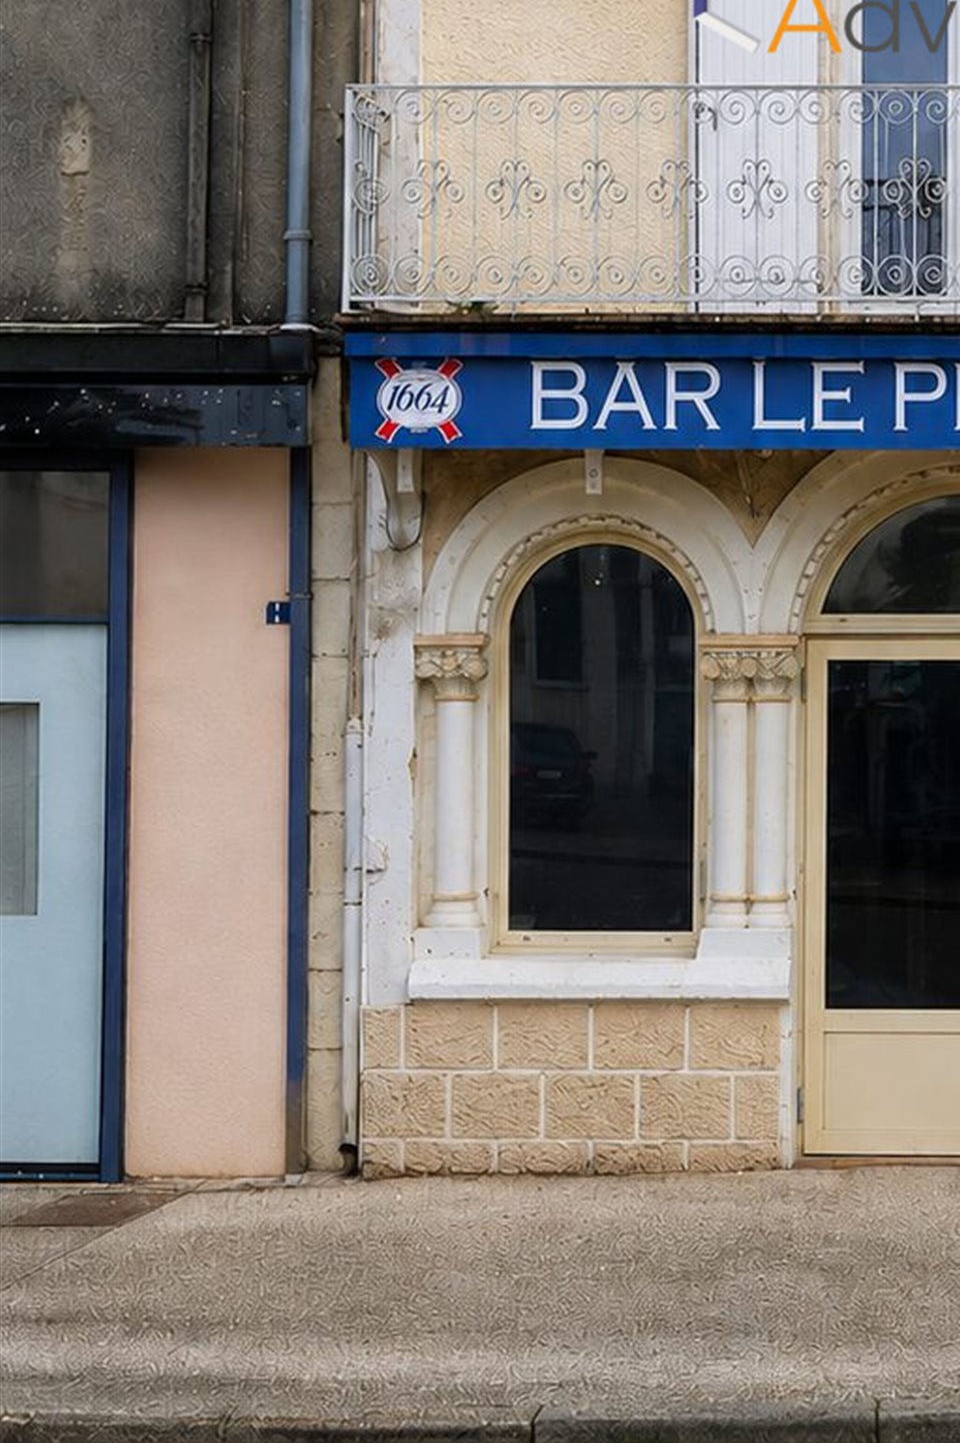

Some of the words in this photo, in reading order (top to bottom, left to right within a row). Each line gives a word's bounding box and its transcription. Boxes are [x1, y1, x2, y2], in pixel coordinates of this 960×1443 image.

[386, 383, 450, 414] 1664
[529, 361, 721, 430] BAR
[751, 361, 866, 431] LE
